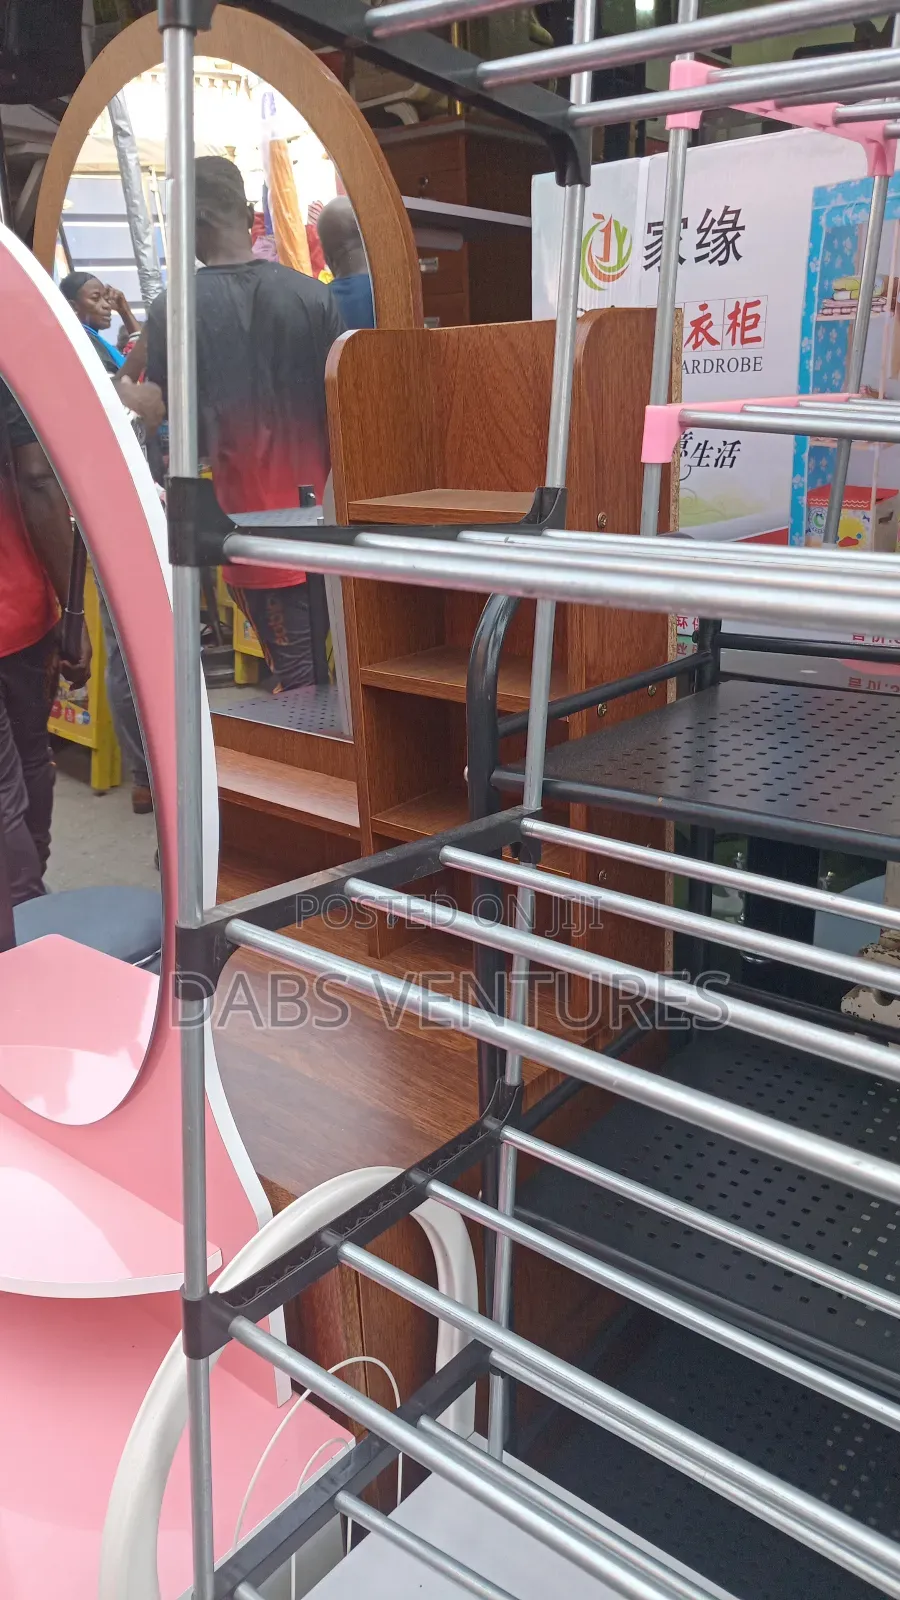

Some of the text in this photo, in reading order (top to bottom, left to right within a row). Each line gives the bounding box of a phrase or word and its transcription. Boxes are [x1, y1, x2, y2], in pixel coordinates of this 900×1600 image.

[643, 205, 746, 272] 家缘
[684, 299, 762, 351] 衣柜
[682, 356, 763, 375] ARDROBE
